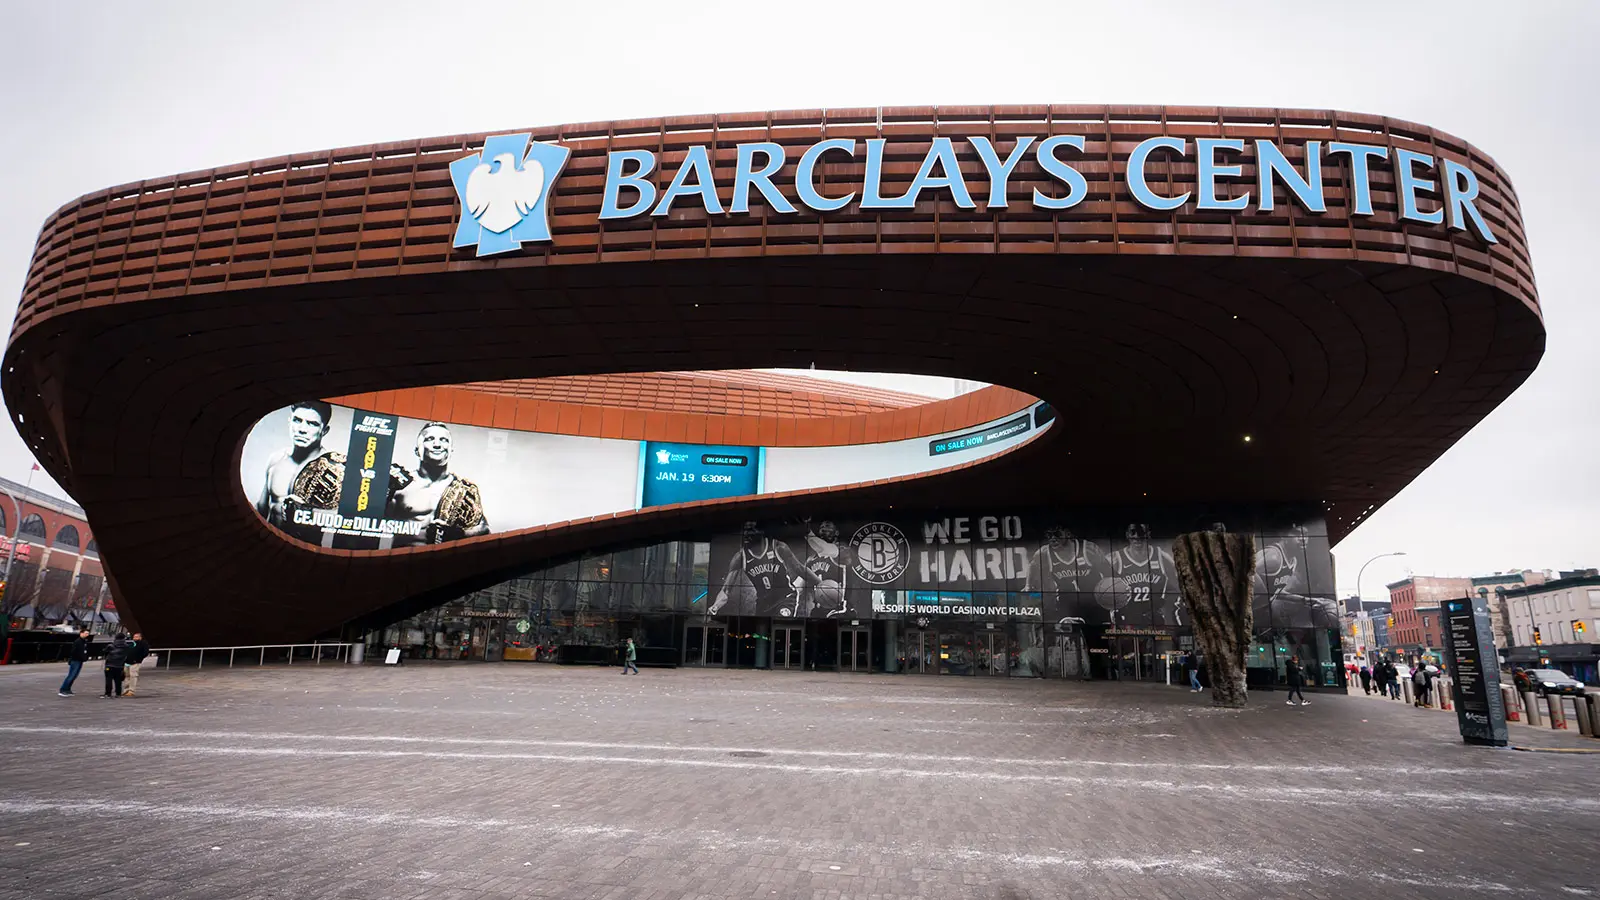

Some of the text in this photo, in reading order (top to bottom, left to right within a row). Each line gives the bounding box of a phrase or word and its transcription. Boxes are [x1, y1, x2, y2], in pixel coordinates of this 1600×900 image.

[597, 135, 1498, 245] BARCLAYS CENTER
[354, 424, 378, 433] FIGHT
[362, 416, 391, 428] UFC
[936, 422, 1026, 452] ON SALE NOW BARCLAYSCENTER.COM
[360, 468, 376, 480] VS
[656, 472, 731, 483] JAN. 19 6:30PM
[293, 509, 343, 528] CEJUDO
[353, 516, 422, 536] DILLASHAW
[924, 515, 1023, 544] WE GO
[852, 525, 904, 546] BROOKLYN
[873, 538, 887, 568] B
[855, 563, 904, 581] NEW YORK
[920, 547, 1029, 583] HARD
[762, 576, 771, 590] 9
[1133, 586, 1150, 602] 22
[874, 604, 1041, 616] RESORTS WORLD CASINO NYC PLAZA
[1483, 651, 1495, 673] DINE
[1487, 681, 1502, 720] UNWIND
